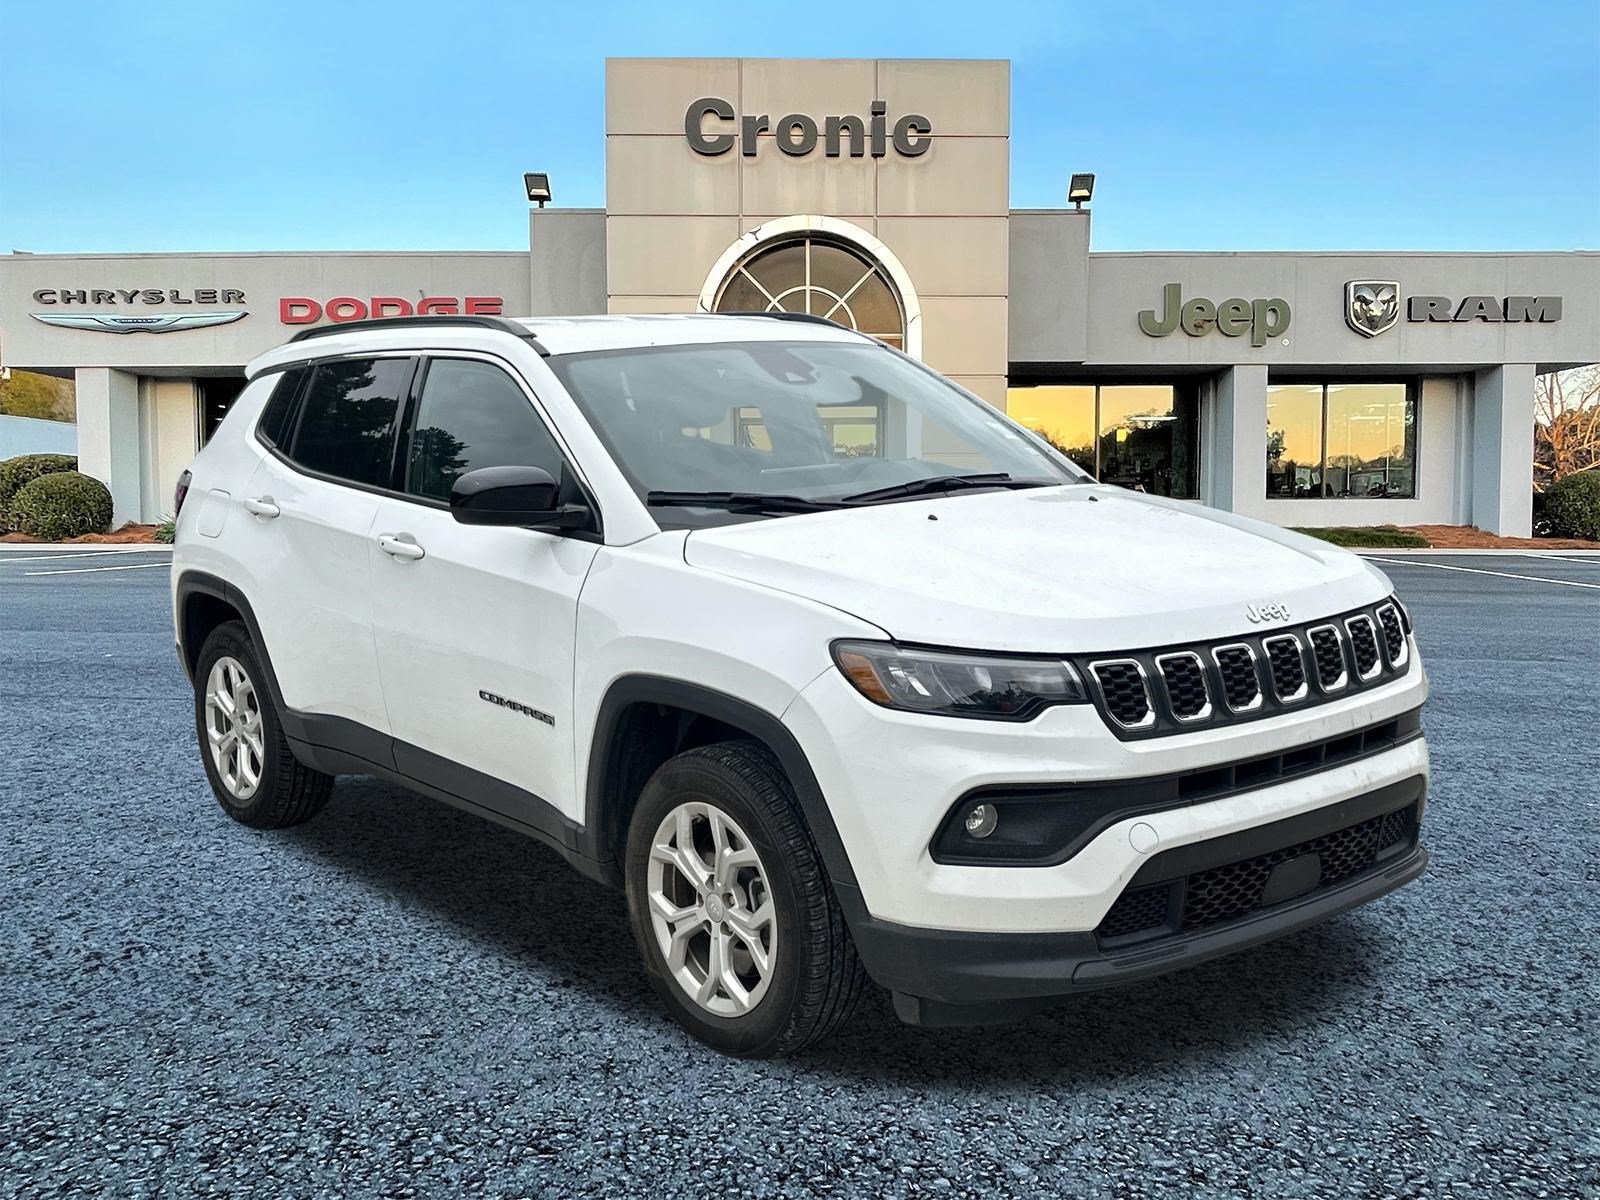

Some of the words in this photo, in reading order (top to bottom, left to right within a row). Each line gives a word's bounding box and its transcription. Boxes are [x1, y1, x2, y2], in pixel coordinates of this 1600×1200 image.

[685, 97, 932, 157] Cronic
[32, 289, 246, 304] CHRYSLER
[1407, 296, 1562, 322] RAM
[279, 297, 503, 325] DODGE
[1138, 283, 1291, 347] Jeep
[1246, 602, 1291, 624] Jeep
[479, 690, 555, 727] COMPASS
